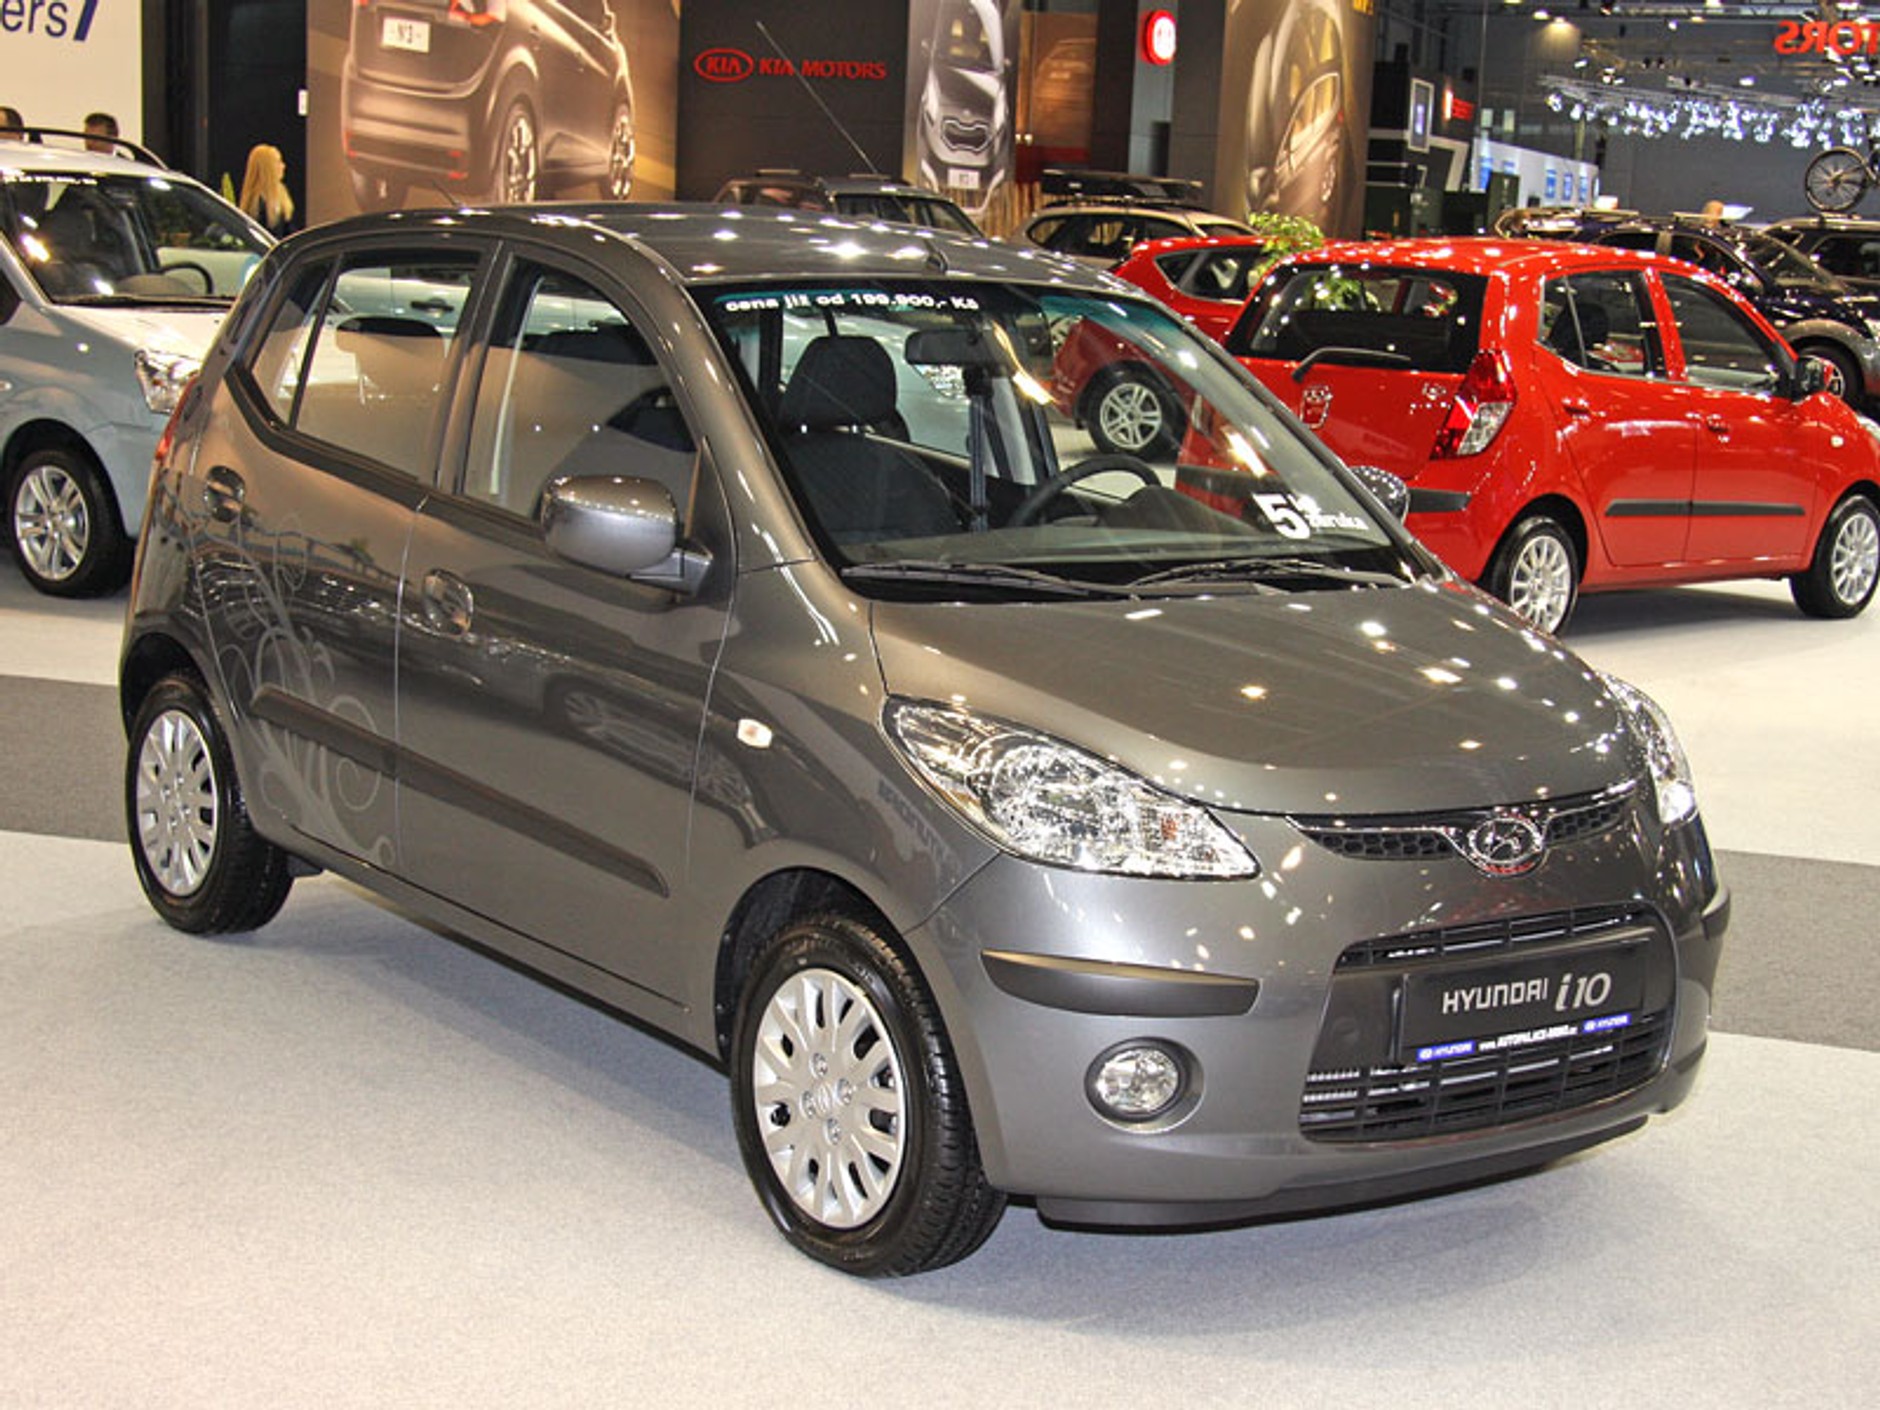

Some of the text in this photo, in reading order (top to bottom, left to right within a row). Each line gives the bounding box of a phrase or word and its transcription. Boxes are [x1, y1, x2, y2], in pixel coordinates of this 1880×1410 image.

[706, 56, 742, 75] KIA
[758, 57, 886, 80] KIA MOTORS
[816, 293, 846, 306] od
[1251, 493, 1311, 539] 5
[1442, 972, 1613, 1015] HYUNDAI i10
